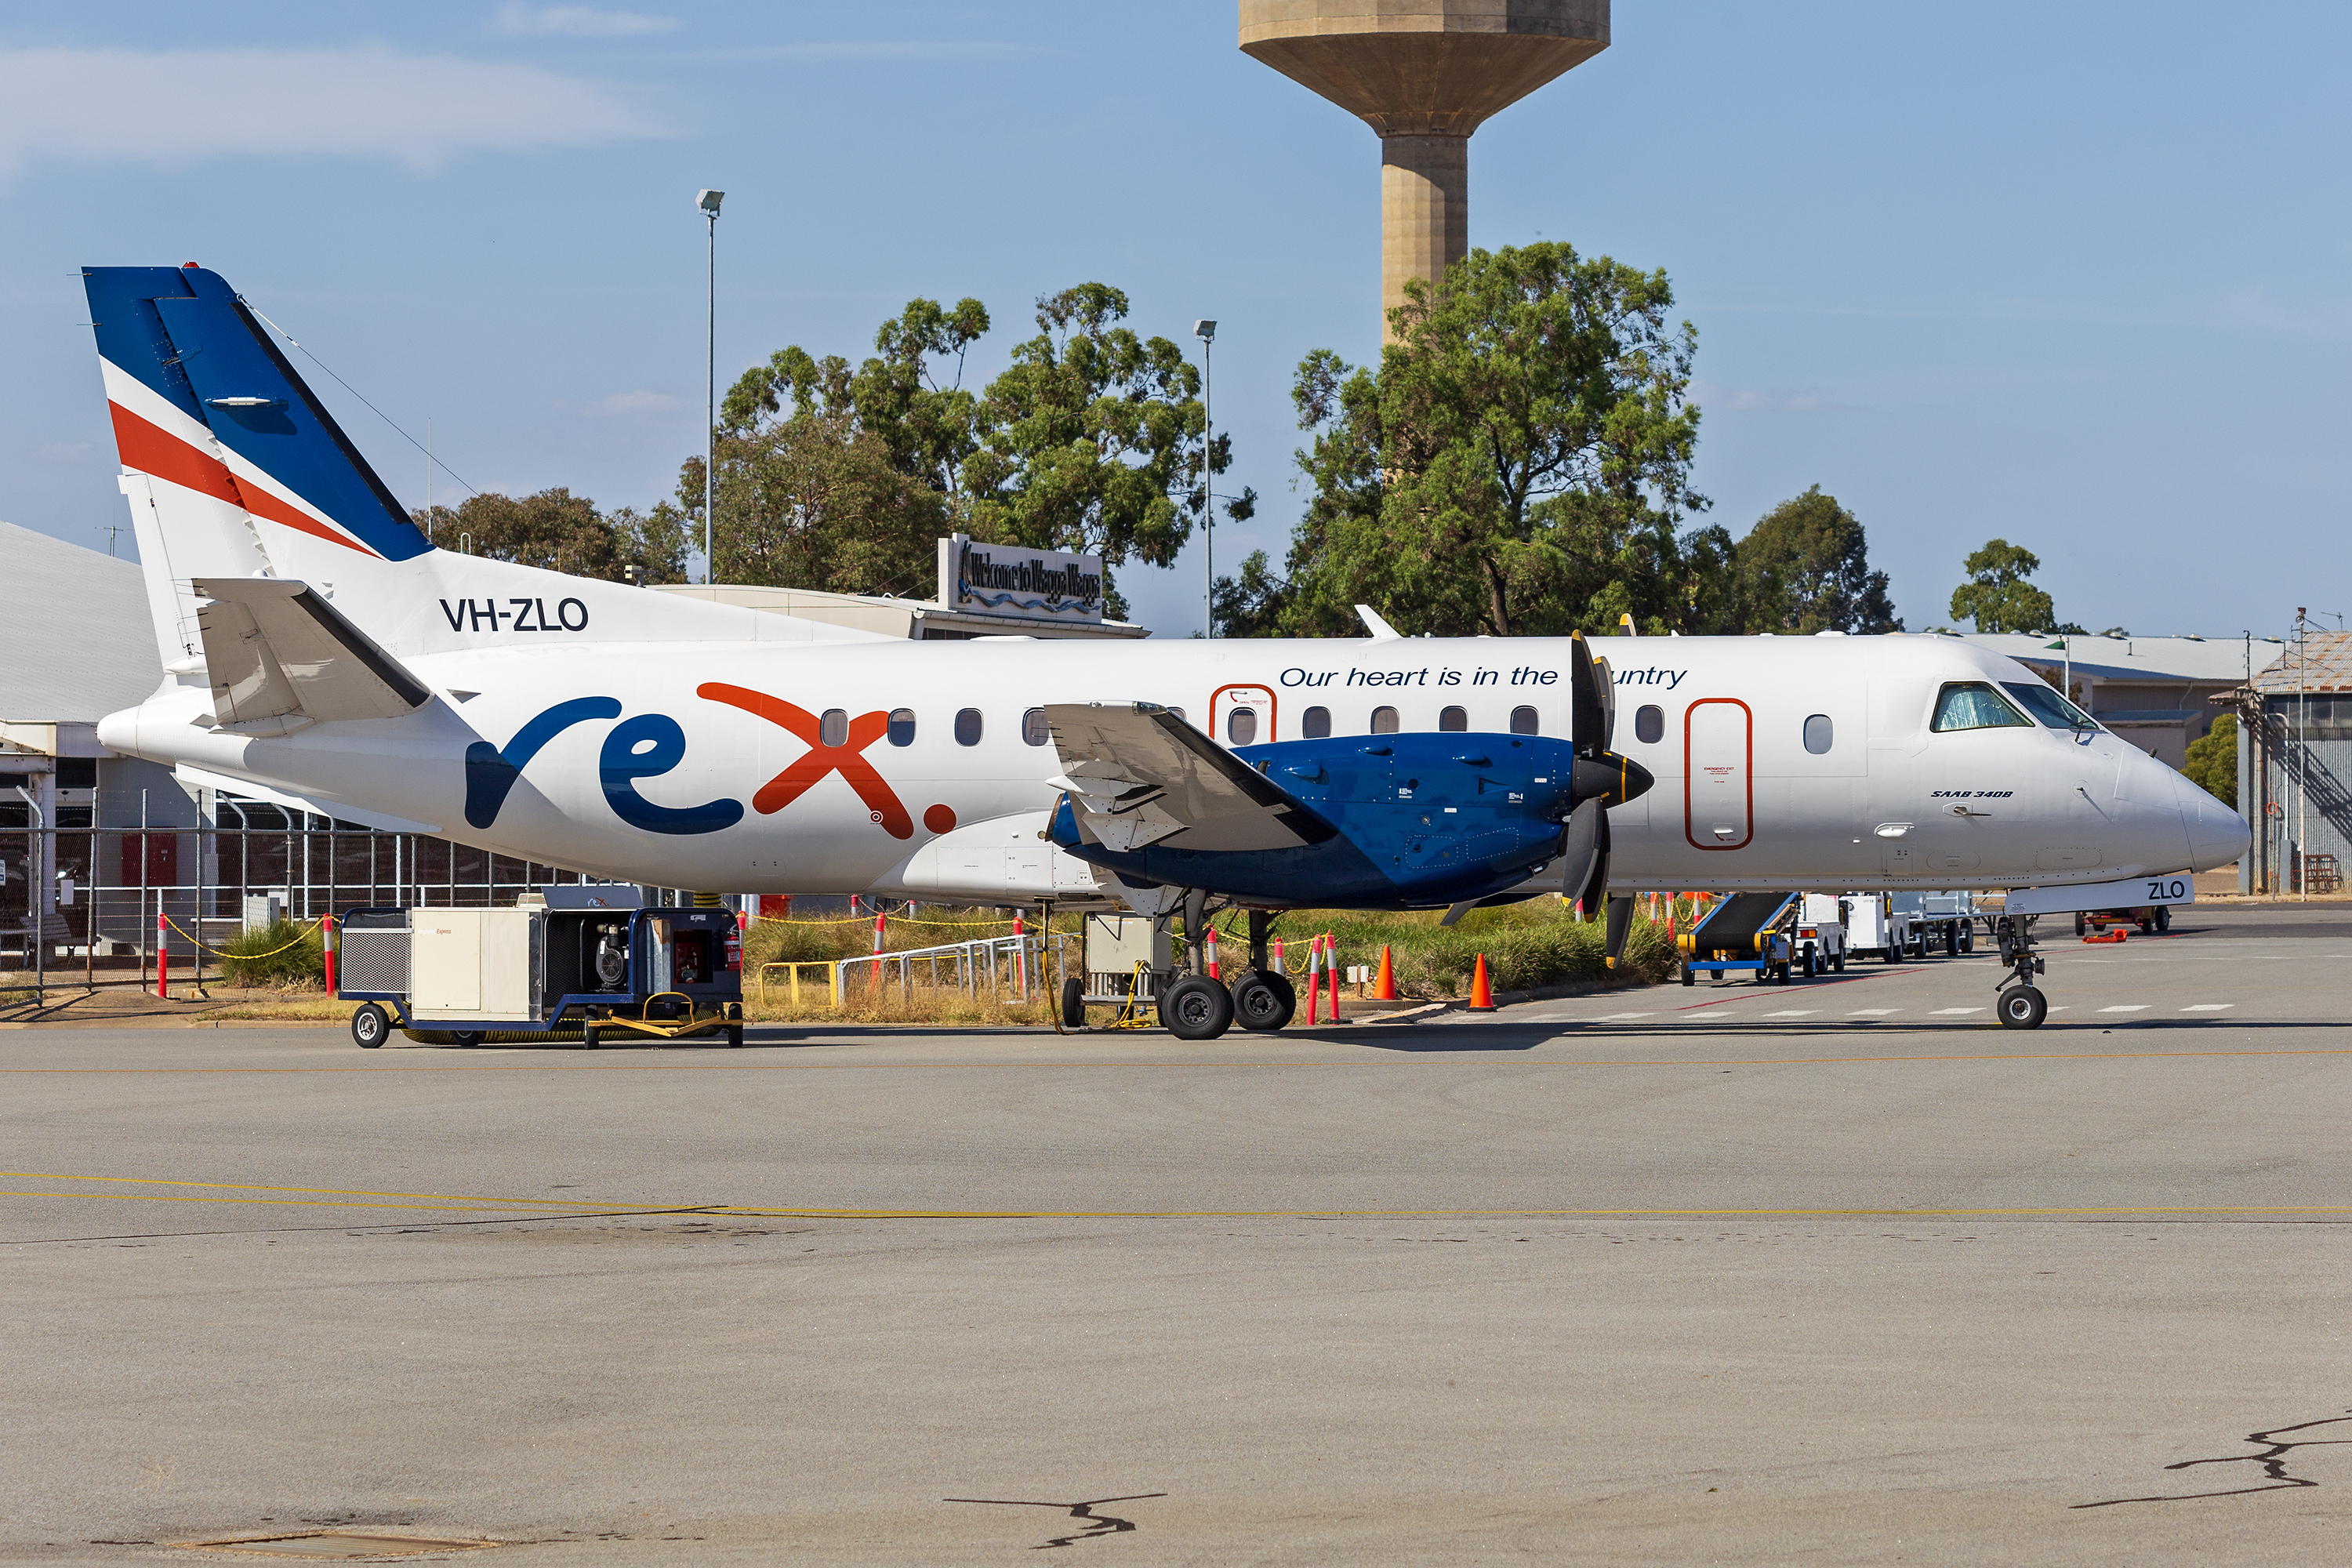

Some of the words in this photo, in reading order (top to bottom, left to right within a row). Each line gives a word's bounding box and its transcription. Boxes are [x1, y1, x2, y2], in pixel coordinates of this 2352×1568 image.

[971, 552, 1018, 591] Welcome
[1019, 561, 1031, 592] to
[1031, 559, 1067, 604] Wagga
[1067, 563, 1101, 608] Wagga
[439, 597, 589, 632] VH-ZLO
[1280, 667, 1339, 687] Our
[1346, 666, 1429, 687] heart
[1438, 666, 1462, 686] is
[1472, 666, 1499, 686] in
[1511, 666, 1559, 686] the
[1571, 666, 1688, 691] untry
[2147, 880, 2185, 901] ZLO
